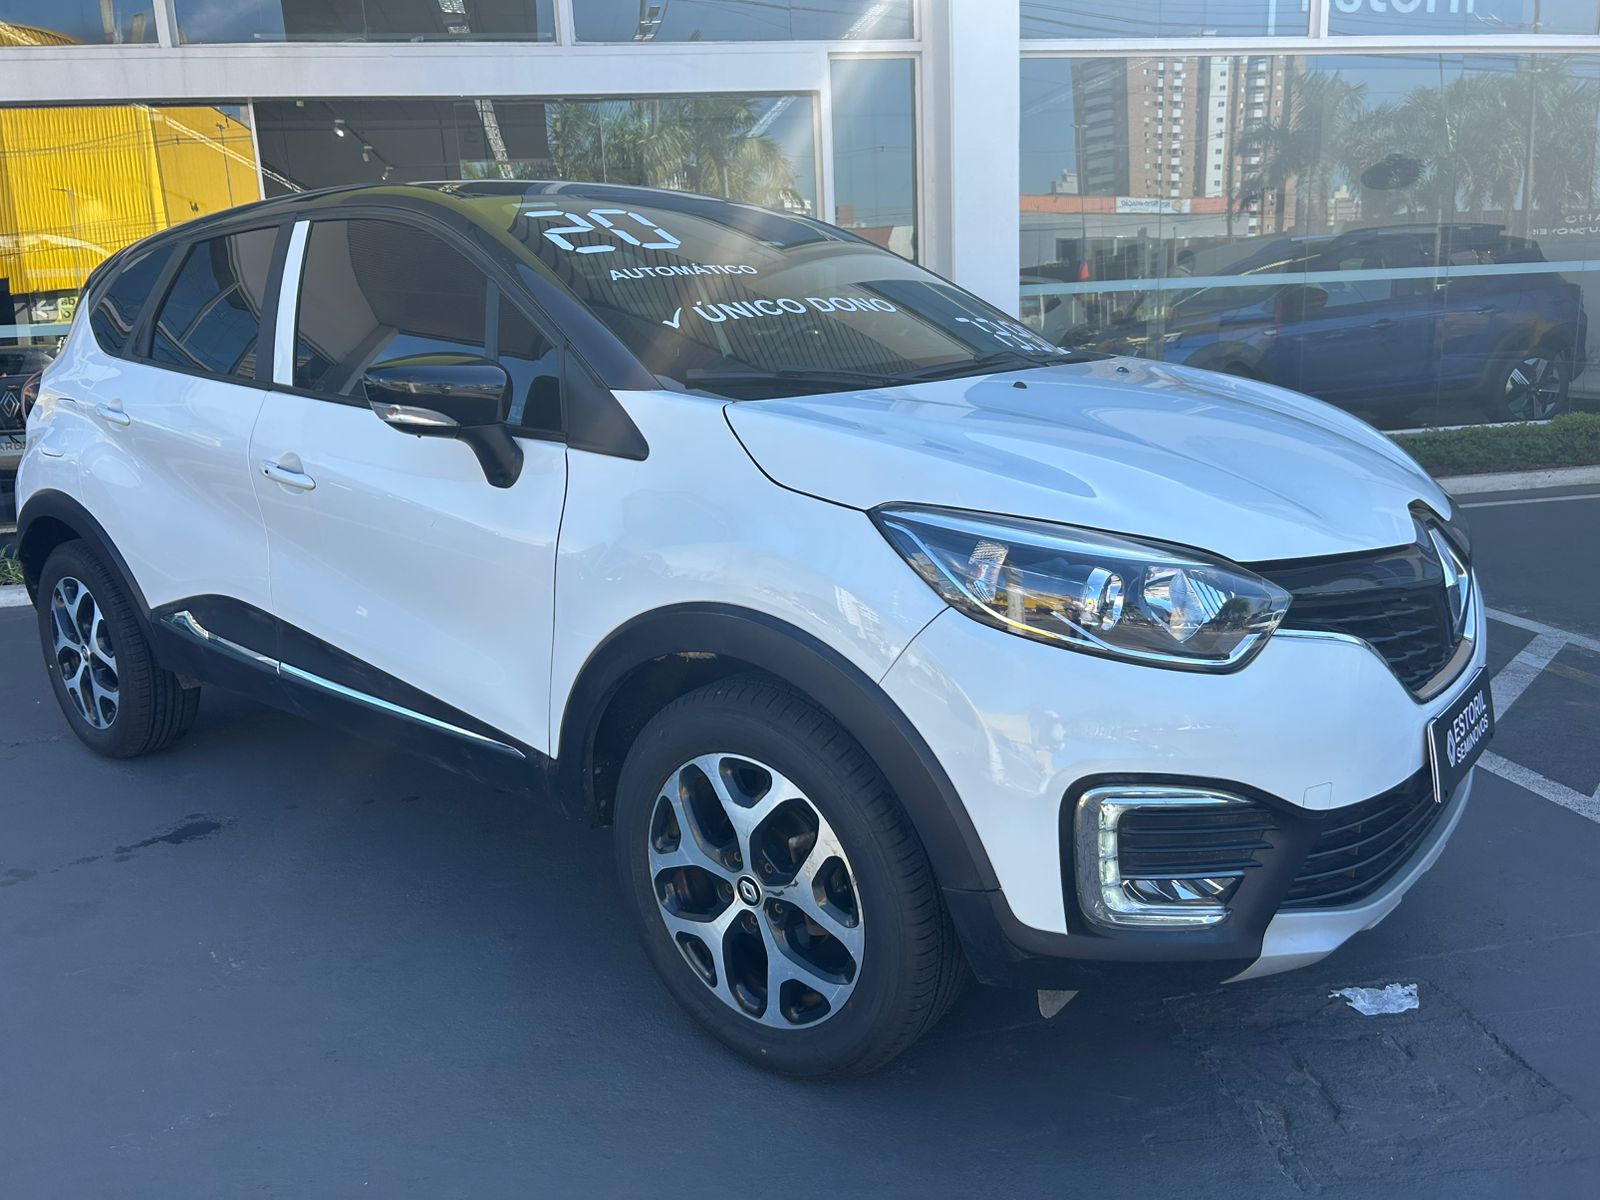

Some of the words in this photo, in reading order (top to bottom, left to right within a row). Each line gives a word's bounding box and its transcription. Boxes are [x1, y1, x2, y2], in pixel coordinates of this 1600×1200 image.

[524, 208, 682, 254] 20
[610, 262, 757, 281] AUTOMÁTICO
[696, 299, 805, 323] ÚNICO
[805, 297, 897, 314] DONO
[1453, 690, 1486, 742] ESTORIL
[1456, 713, 1488, 763] SEMINOVOS
